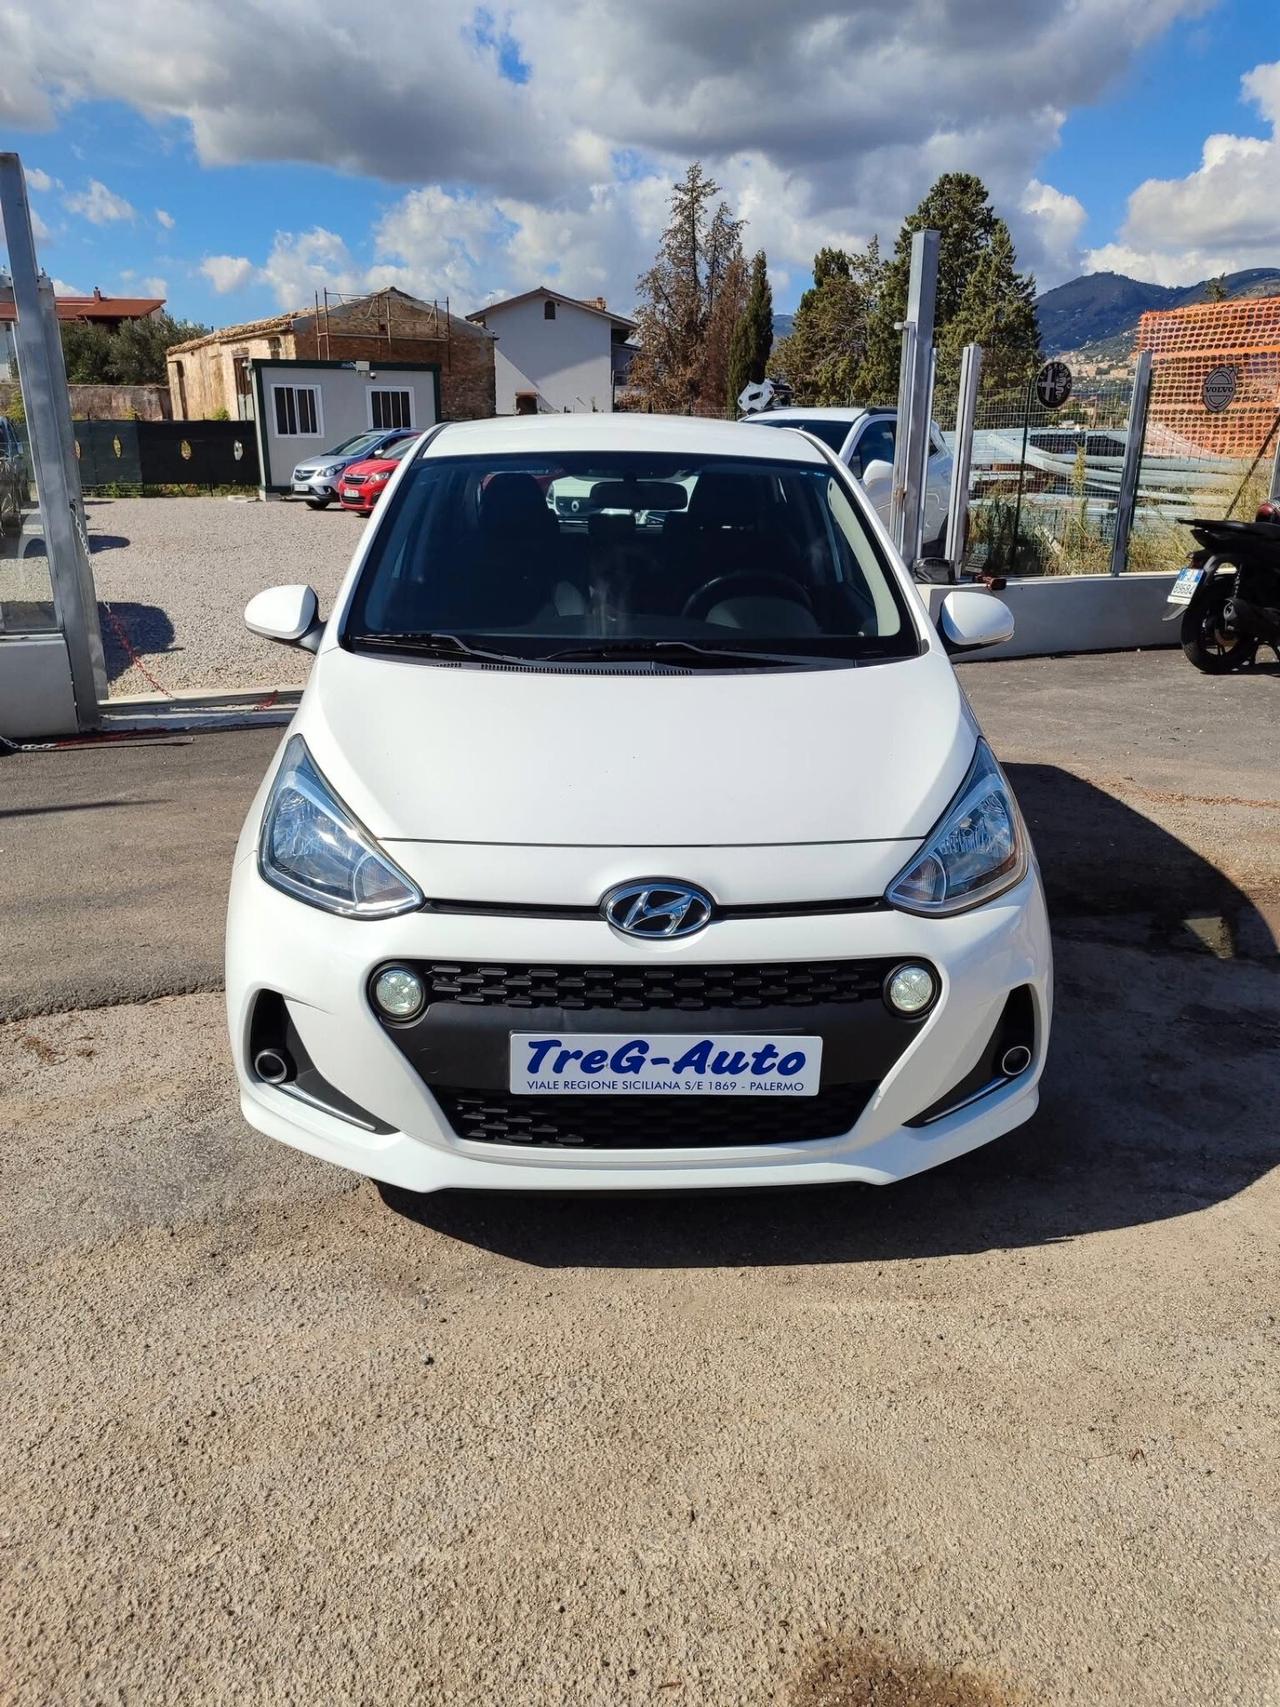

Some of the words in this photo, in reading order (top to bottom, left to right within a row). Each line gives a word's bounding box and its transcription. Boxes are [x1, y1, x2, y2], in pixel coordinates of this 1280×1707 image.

[527, 1039, 807, 1076] TreG-Auto
[527, 1080, 559, 1090] VIALE
[563, 1080, 618, 1090] REGIONE
[622, 1080, 681, 1090] SICILIANA
[684, 1081, 704, 1091] S/E
[708, 1081, 737, 1091] 1869
[749, 1081, 805, 1091] PALERMO
